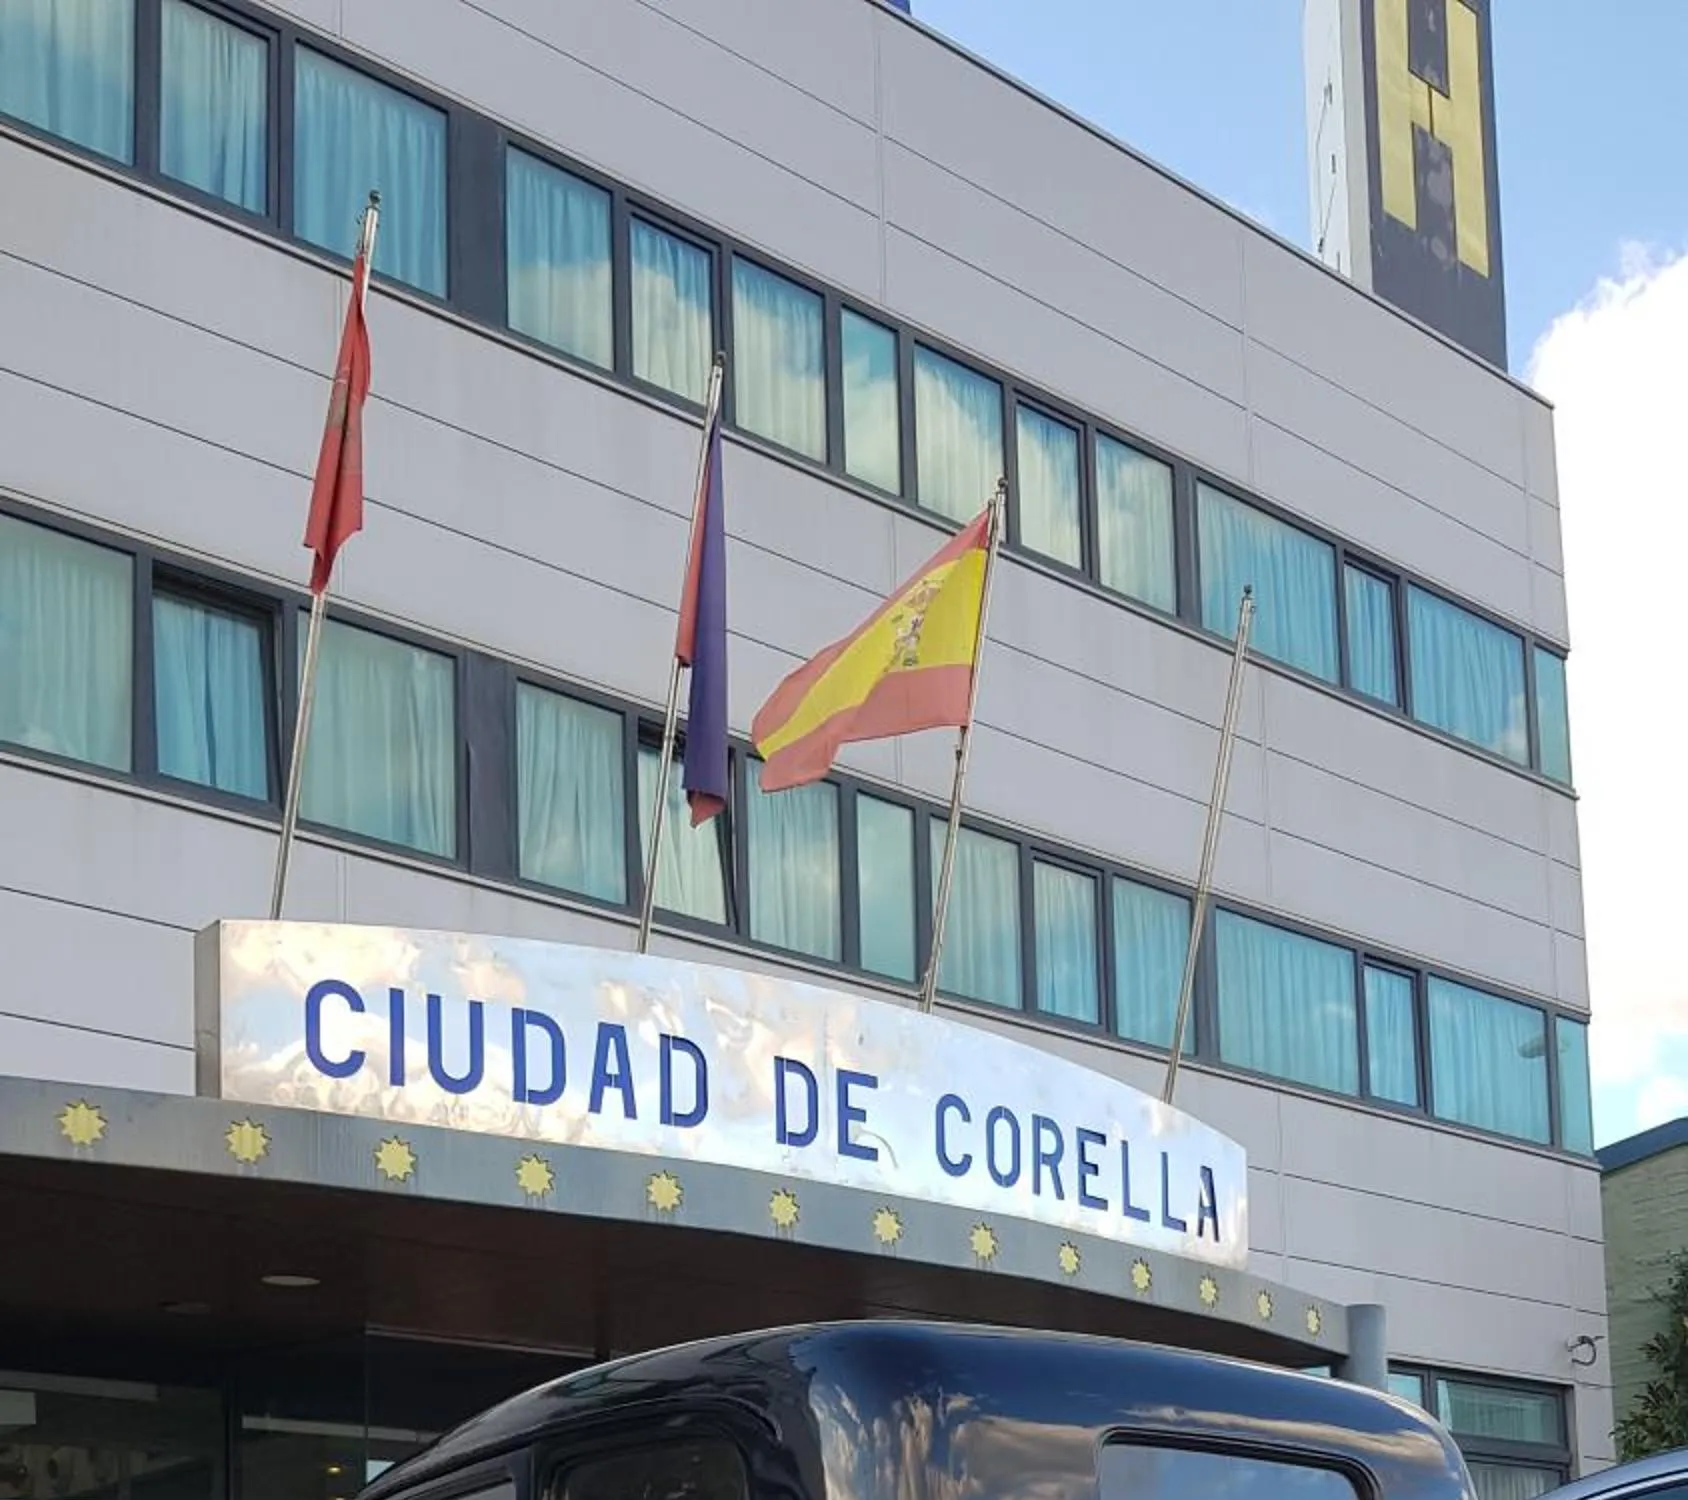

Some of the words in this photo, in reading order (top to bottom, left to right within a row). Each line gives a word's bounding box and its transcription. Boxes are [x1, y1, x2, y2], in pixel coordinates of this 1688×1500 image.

[304, 979, 710, 1129] CIUDAD
[774, 1056, 880, 1162] DE
[934, 1092, 1221, 1242] CORELLA
